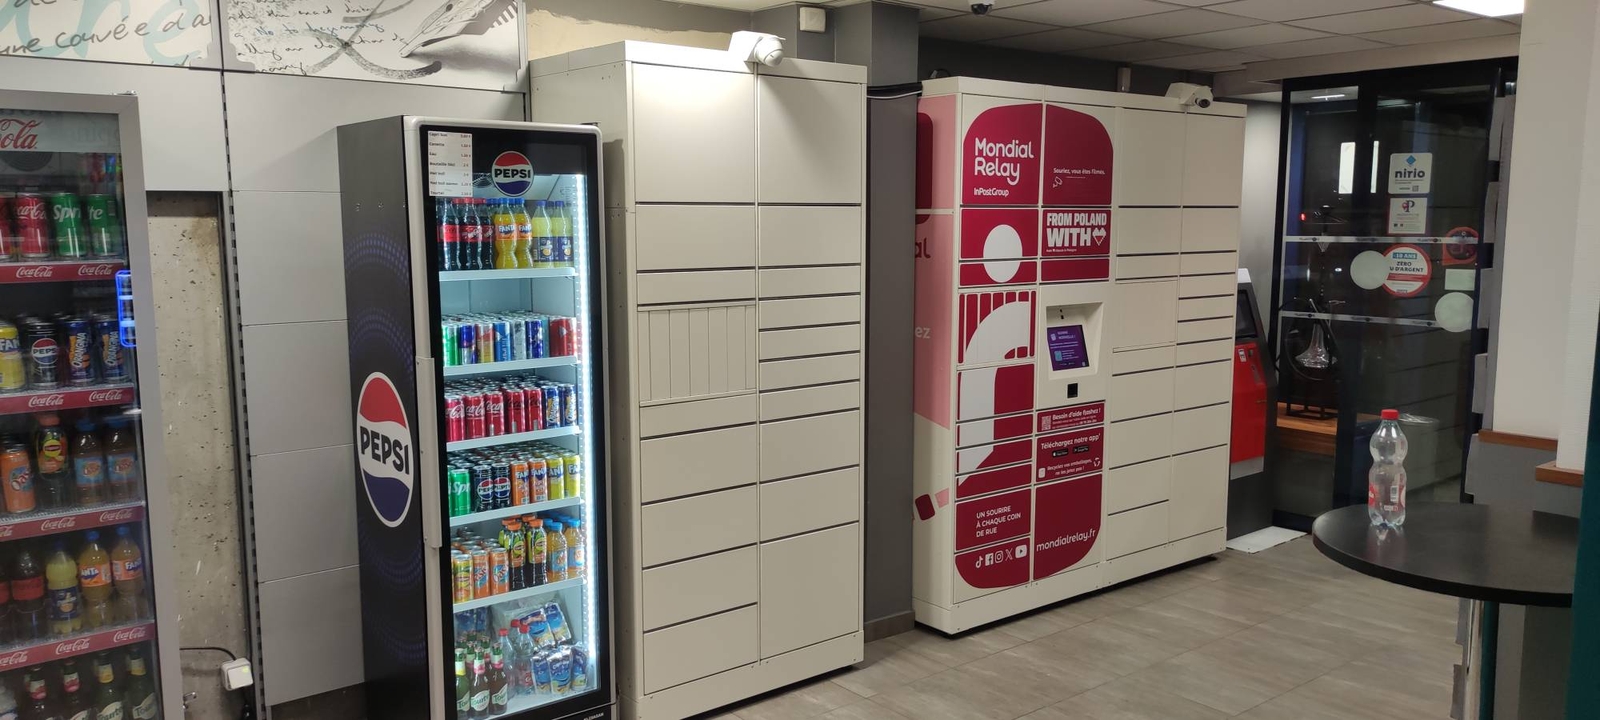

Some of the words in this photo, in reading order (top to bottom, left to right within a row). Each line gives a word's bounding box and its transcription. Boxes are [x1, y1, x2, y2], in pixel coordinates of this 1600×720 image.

[974, 137, 1034, 158] Mondial
[494, 168, 531, 178] PEPSI
[974, 157, 1020, 186] Relay
[1394, 168, 1426, 178] nirio
[1047, 212, 1072, 226] FROM
[1074, 212, 1107, 226] POLAND
[1046, 227, 1091, 247] WITH
[360, 425, 410, 475] PEPSI
[1041, 439, 1074, 450] Téléchargez
[1074, 436, 1088, 444] notre
[986, 505, 1011, 517] SOURIRE
[982, 516, 1006, 527] CHAQUE
[1007, 512, 1022, 521] COIN
[976, 530, 984, 538] DE
[985, 527, 998, 536] RUE
[1036, 528, 1096, 552] mondialrelay.fr
